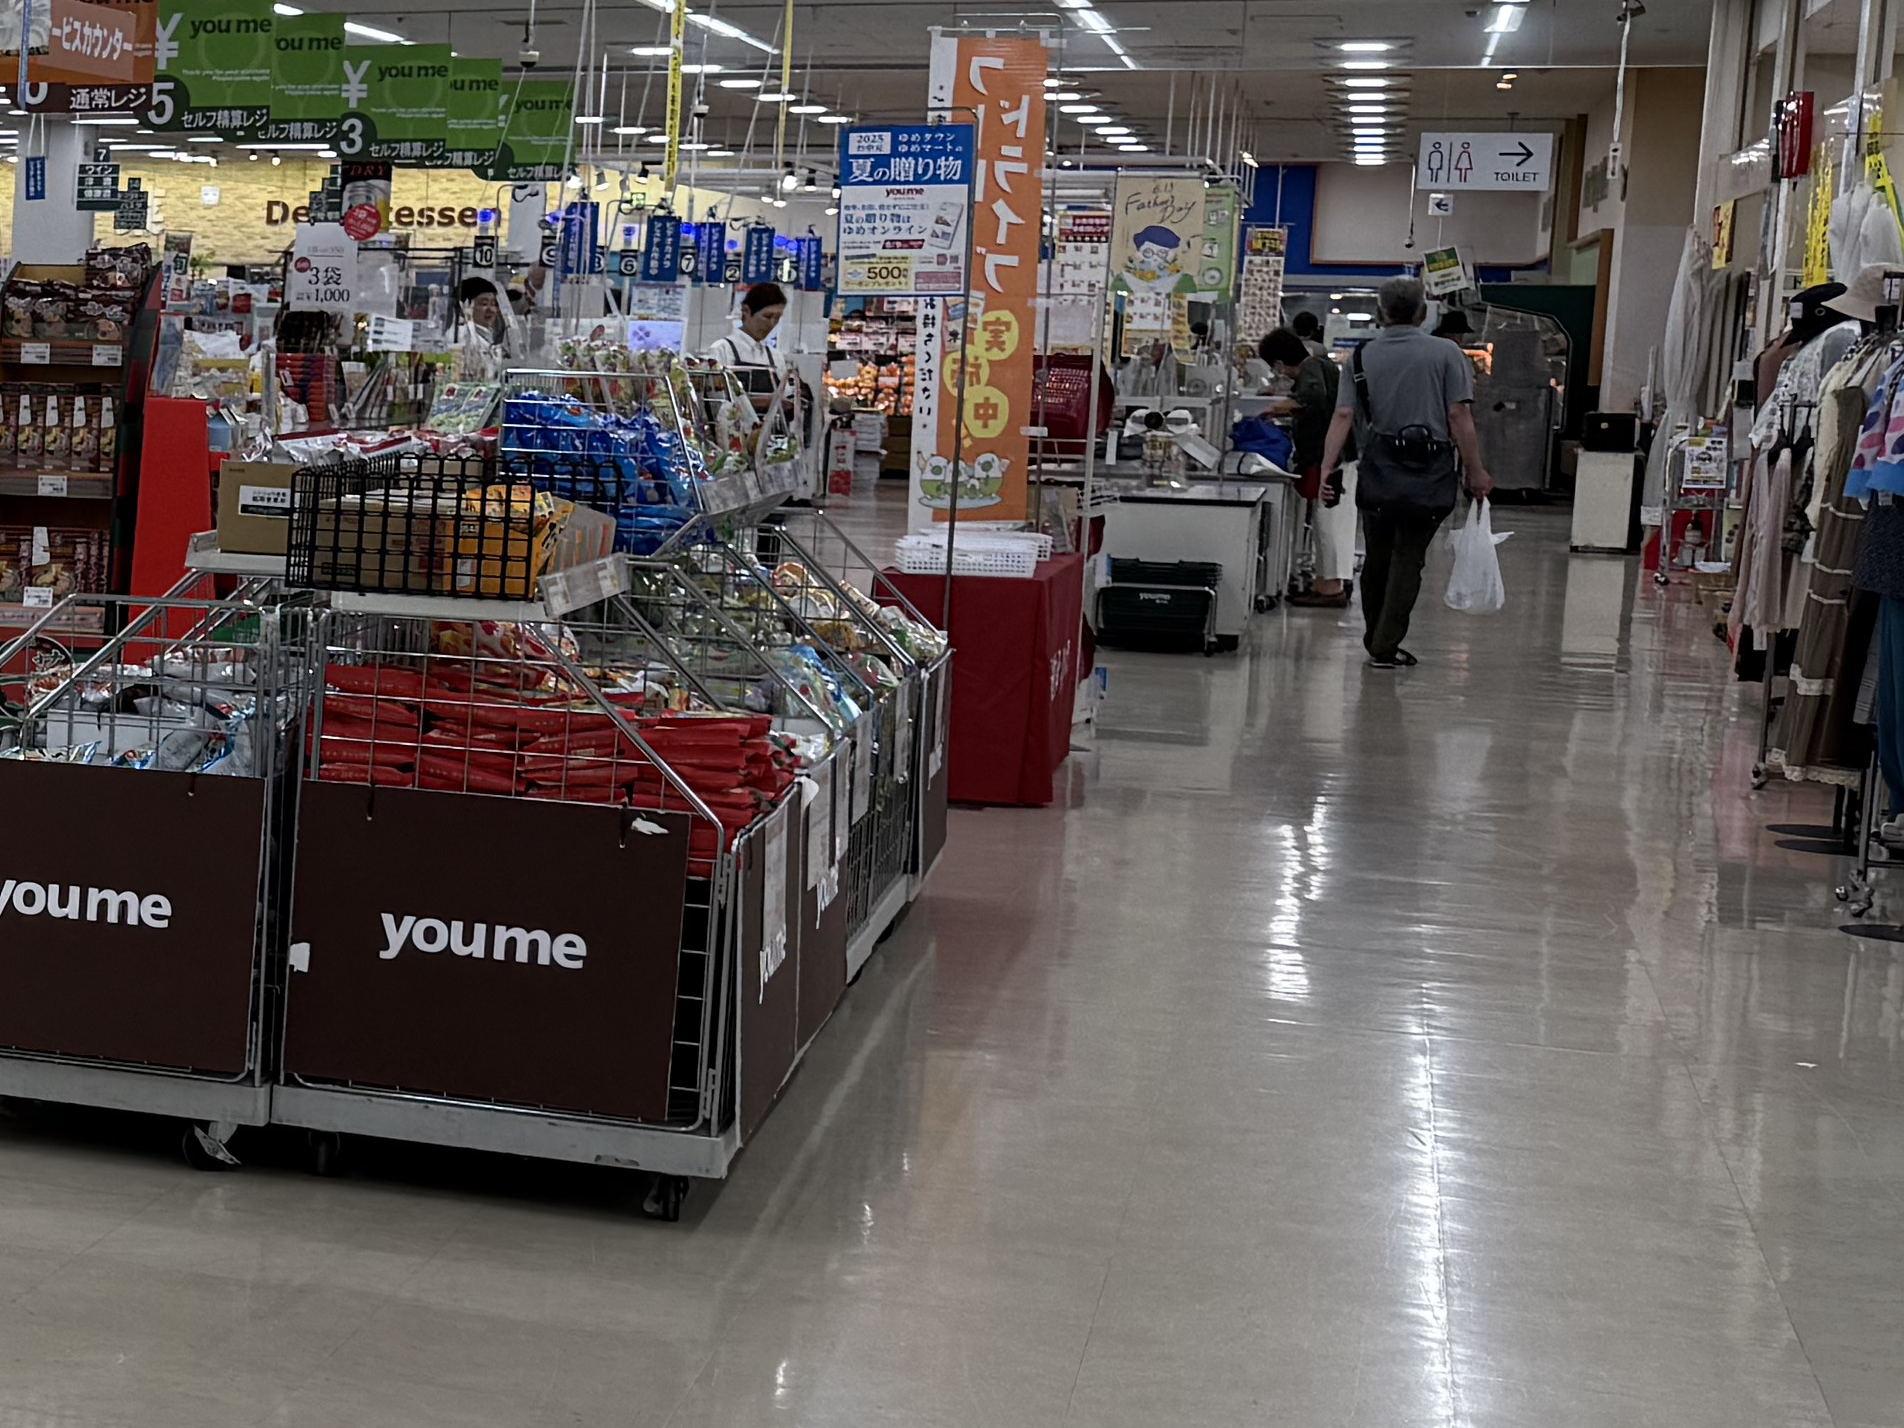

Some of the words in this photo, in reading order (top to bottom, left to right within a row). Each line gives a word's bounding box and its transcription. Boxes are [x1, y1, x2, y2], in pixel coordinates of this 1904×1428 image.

[52, 17, 133, 60] ービスカウンター
[70, 88, 146, 110] 通常レジ
[148, 82, 175, 125] 5
[181, 109, 267, 129] セルフ精算レジ
[340, 118, 362, 155] 3
[857, 135, 884, 143] 2025
[898, 133, 955, 142] ゆめタウン
[97, 149, 107, 161] 7
[369, 141, 443, 158] セルフ精算レジ
[898, 144, 963, 153] ゆめマートの
[848, 156, 963, 183] 夏の贈り物
[1494, 171, 1538, 184] TOILET
[843, 225, 927, 236] ゆめオンライン
[867, 266, 902, 279] 500
